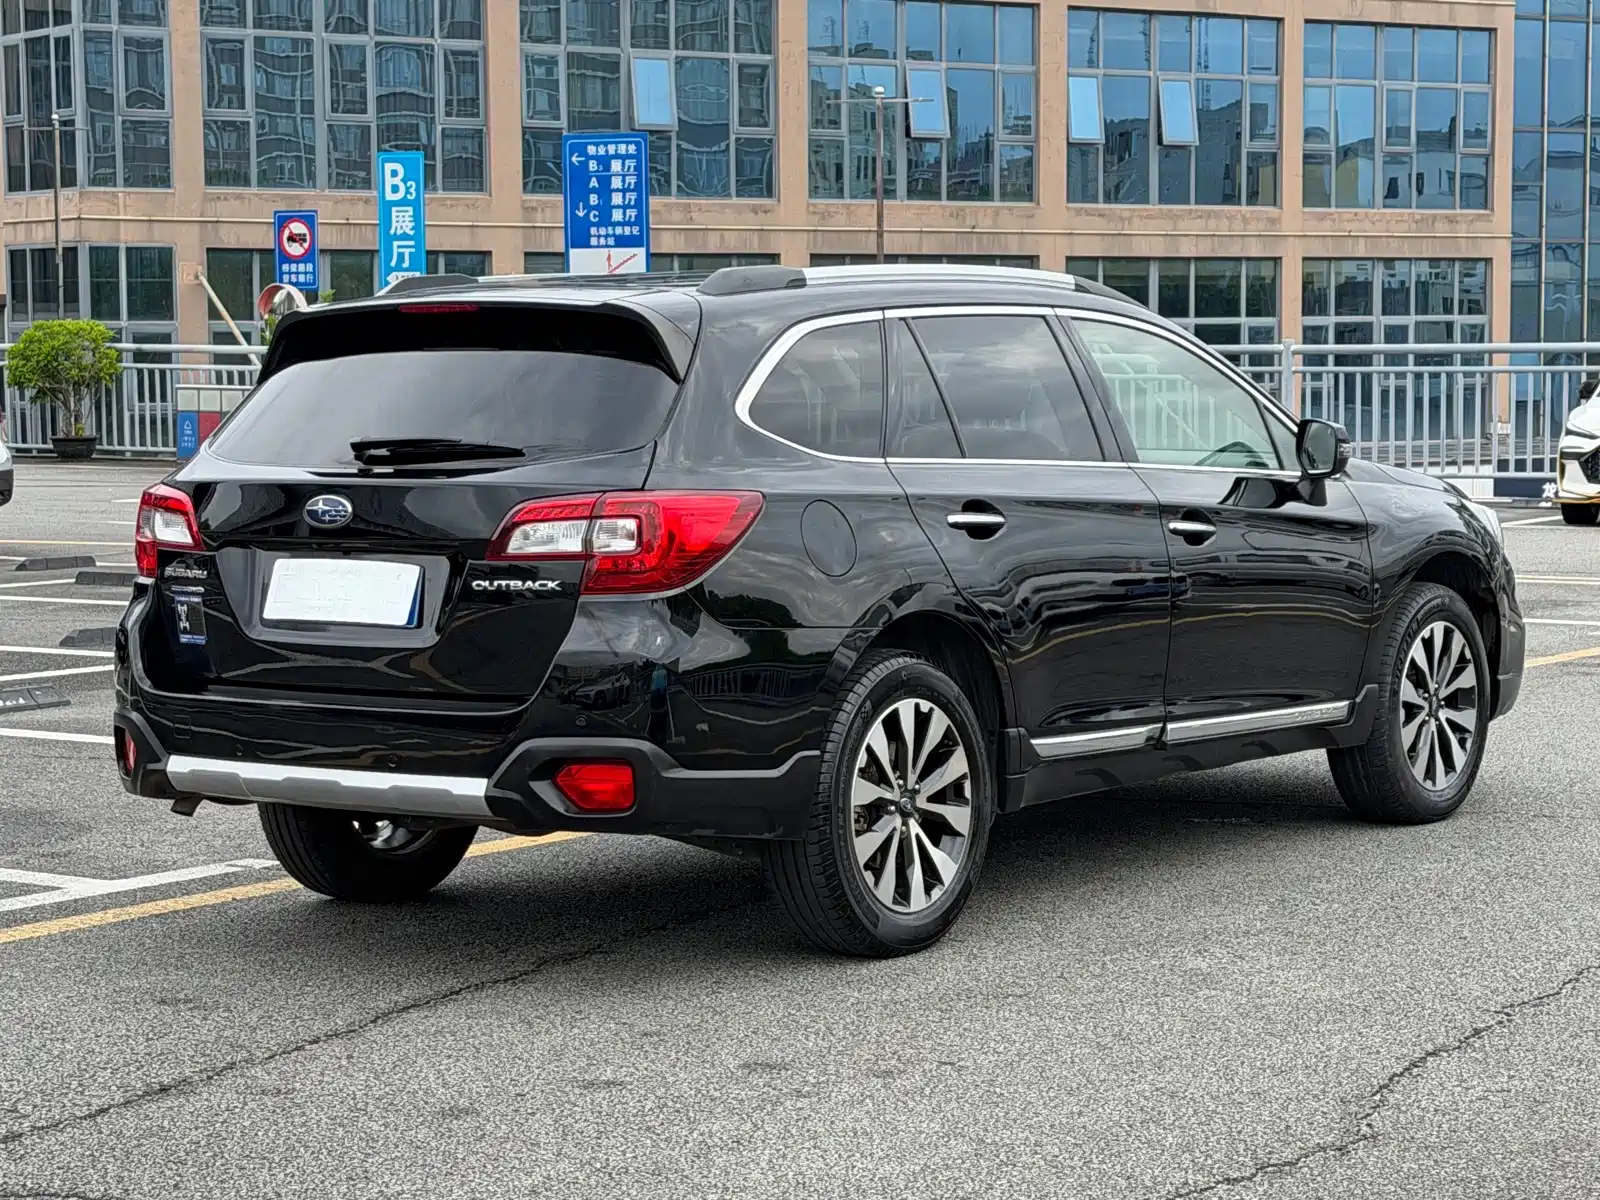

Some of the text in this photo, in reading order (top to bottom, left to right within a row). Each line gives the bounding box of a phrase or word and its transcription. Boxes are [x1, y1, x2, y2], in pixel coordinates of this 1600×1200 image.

[587, 144, 637, 155] 物业管理处
[610, 159, 637, 173] 展厅
[384, 163, 416, 200] B3
[589, 176, 637, 189] A 展厅
[611, 192, 638, 205] 展厅
[589, 209, 638, 222] C 展厅
[389, 207, 416, 268] 展厅
[164, 567, 208, 578] SUBARU
[472, 580, 562, 590] OUTBACK
